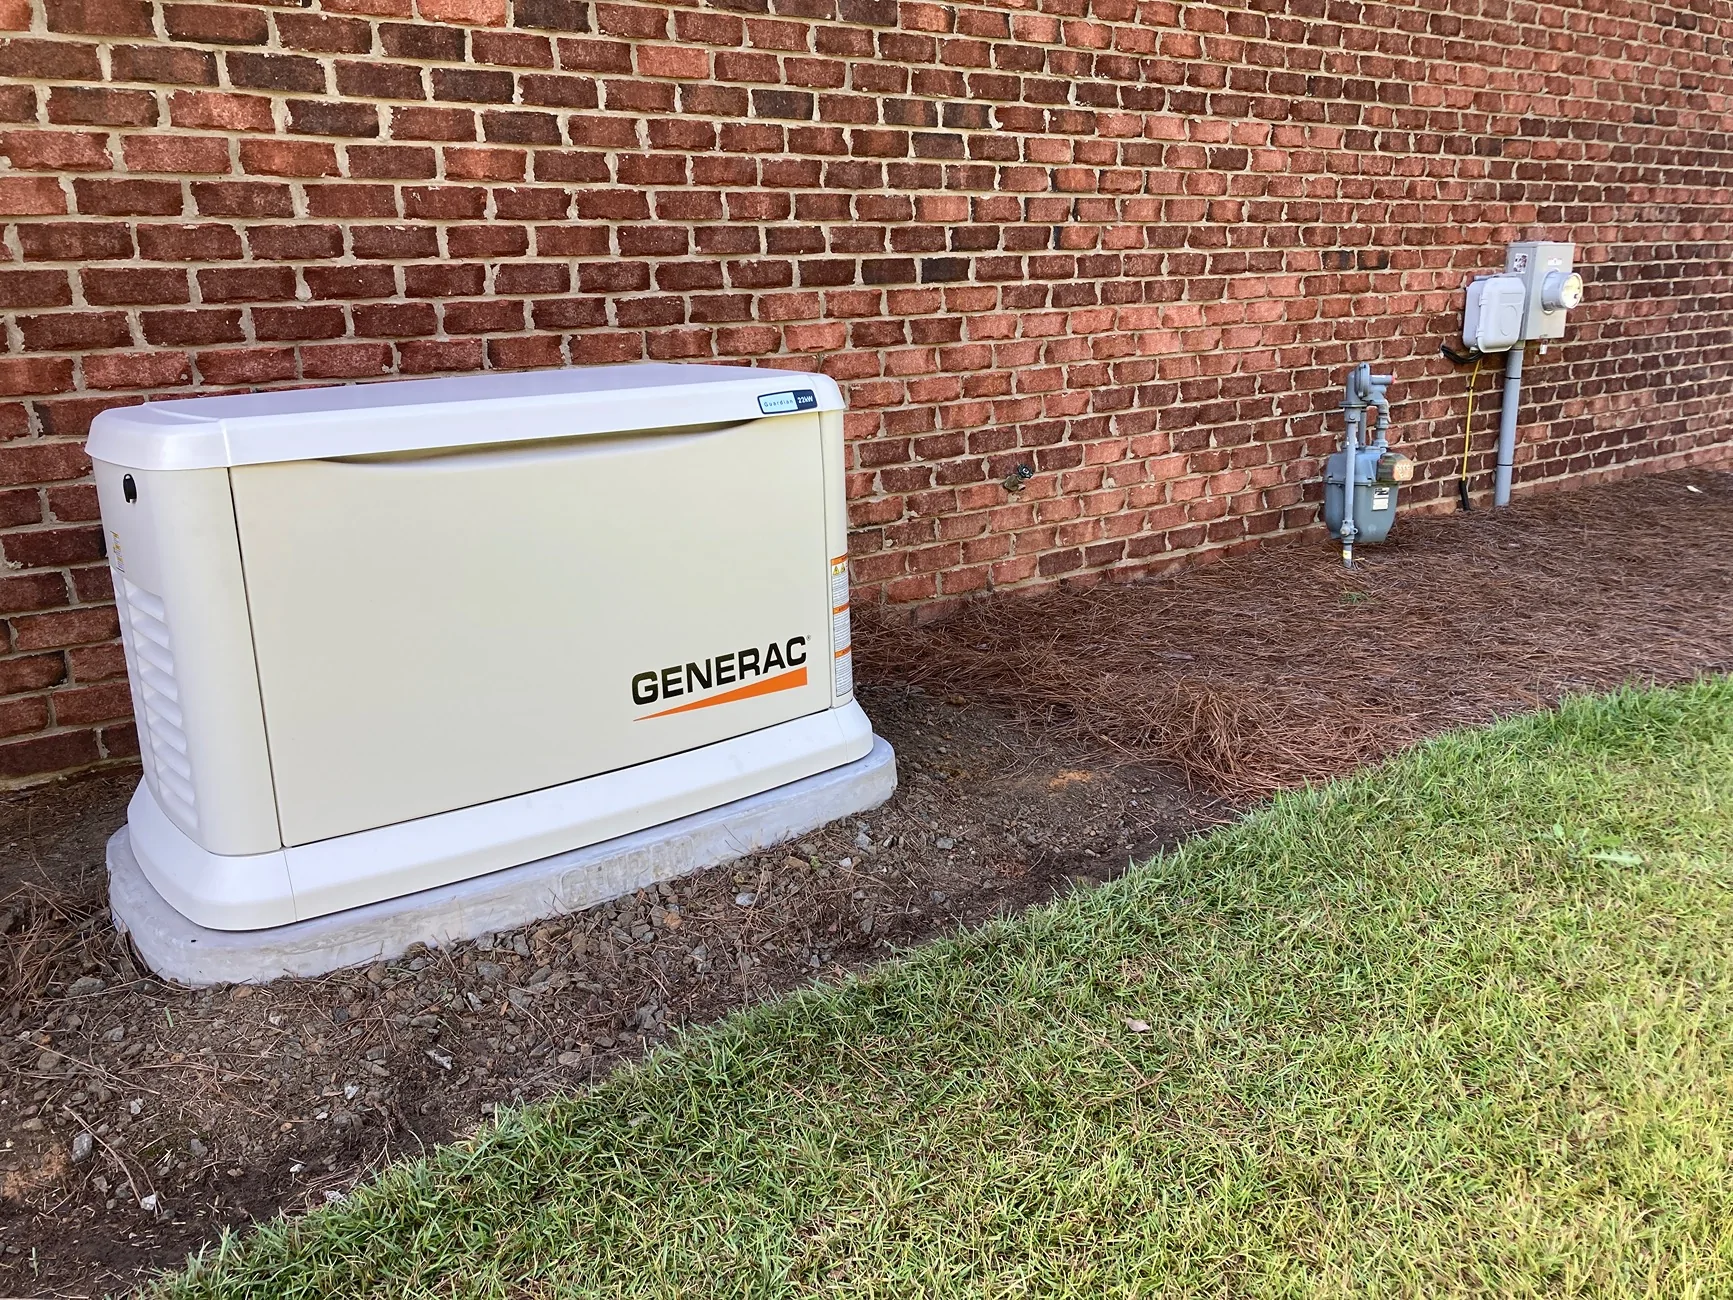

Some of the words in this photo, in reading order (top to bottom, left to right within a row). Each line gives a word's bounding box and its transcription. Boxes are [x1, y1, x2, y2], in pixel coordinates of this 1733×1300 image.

[763, 399, 794, 407] Guardian
[797, 395, 813, 404] 22kW
[631, 635, 807, 705] GENERAC
